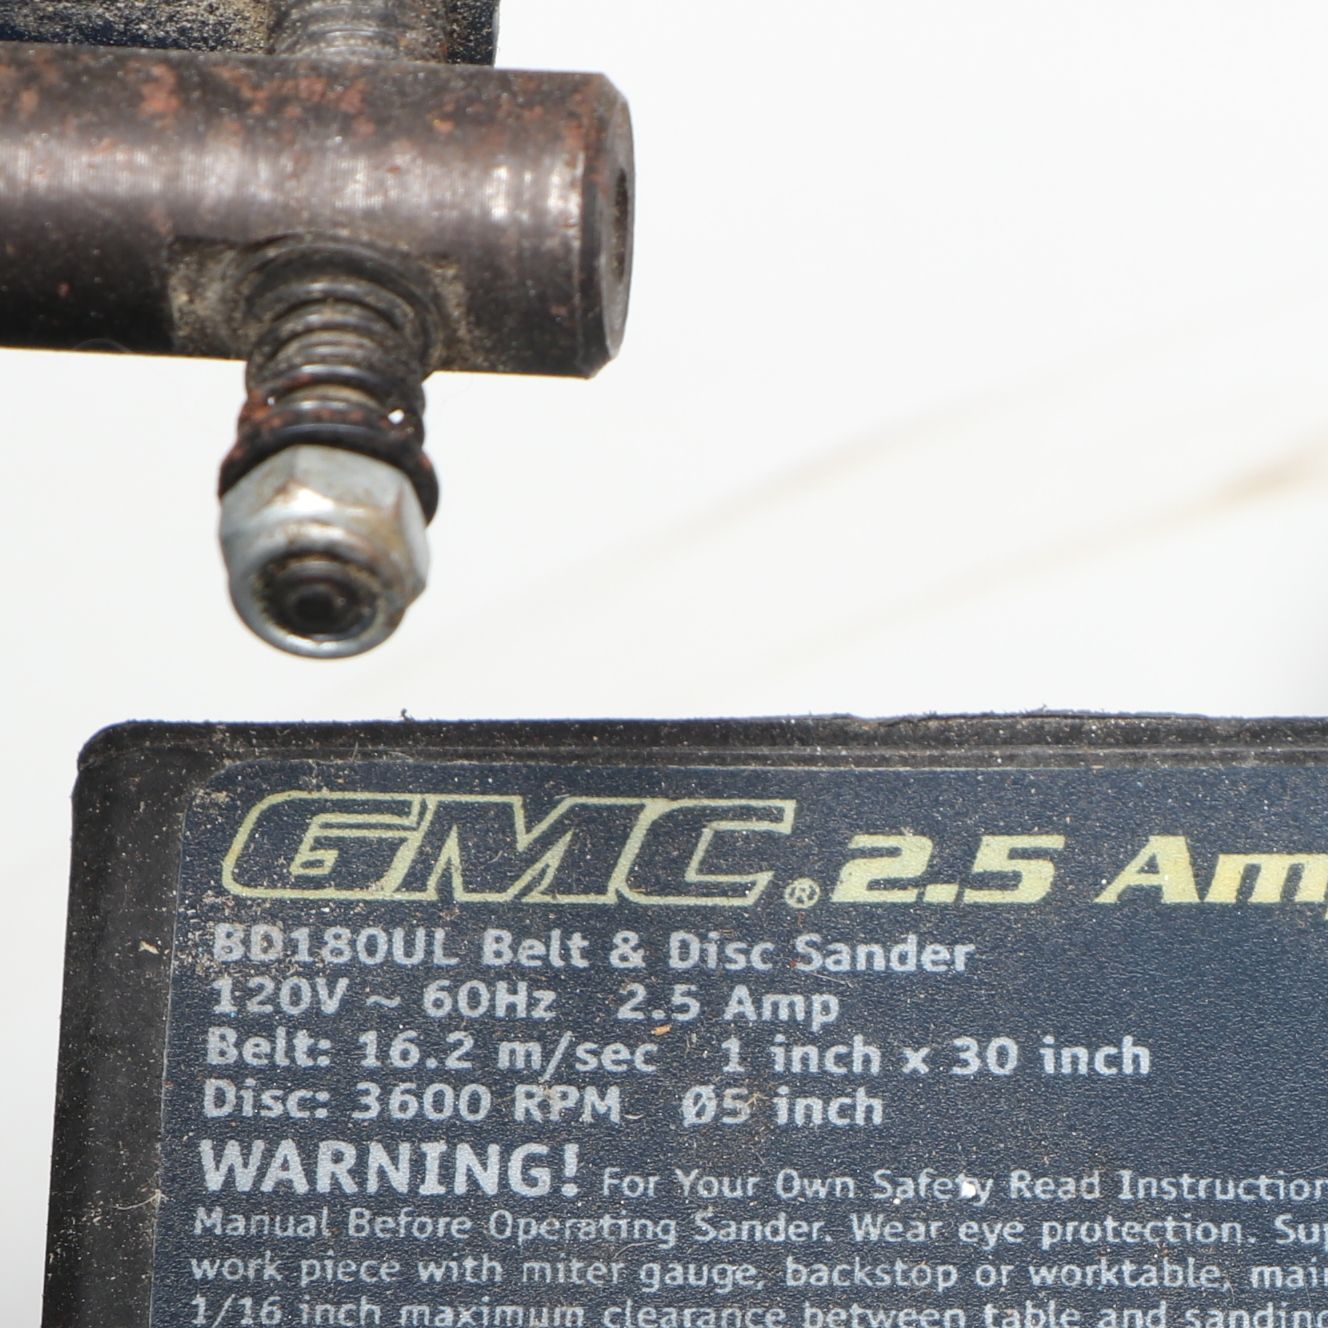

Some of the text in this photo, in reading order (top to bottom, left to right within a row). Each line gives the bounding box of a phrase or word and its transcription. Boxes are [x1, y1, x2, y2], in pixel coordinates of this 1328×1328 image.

[830, 834, 1065, 904] 2.5
[212, 924, 976, 975] BD180UL Belt & Disc Sander
[212, 977, 347, 1016] 120V
[422, 980, 556, 1019] 60Hz
[617, 985, 700, 1021] 2.5
[723, 985, 841, 1030] Amp
[207, 1028, 1150, 1083] Belt: 16.2 m/sec 1 inch x 30 inch
[203, 1079, 328, 1119] Disc:
[351, 1083, 490, 1121] 3600
[513, 1085, 620, 1123] RPM
[771, 1088, 885, 1128] inch
[199, 1140, 579, 1197] WARNING!
[603, 1170, 659, 1199] For
[675, 1170, 758, 1199] Your
[776, 1170, 856, 1201] Own
[873, 1170, 991, 1204] Safety
[1010, 1172, 1099, 1200] Read
[193, 1206, 329, 1238] Manual
[348, 1208, 473, 1240] Before
[489, 1210, 677, 1247] Operating
[694, 1212, 833, 1243] Sander.
[851, 1215, 944, 1243] Wear
[959, 1222, 1024, 1248] eye
[1042, 1215, 1255, 1249] protection.
[192, 1250, 280, 1282] work
[300, 1251, 400, 1290] piece
[418, 1254, 502, 1284] with
[522, 1255, 625, 1285] miter
[640, 1263, 765, 1291] gauge,
[785, 1255, 958, 1290] backstop
[976, 1264, 1013, 1287] or
[1030, 1258, 1230, 1290] worktable,
[191, 1298, 282, 1328] 1/16
[299, 1296, 380, 1328] inch
[400, 1297, 584, 1328] maximum
